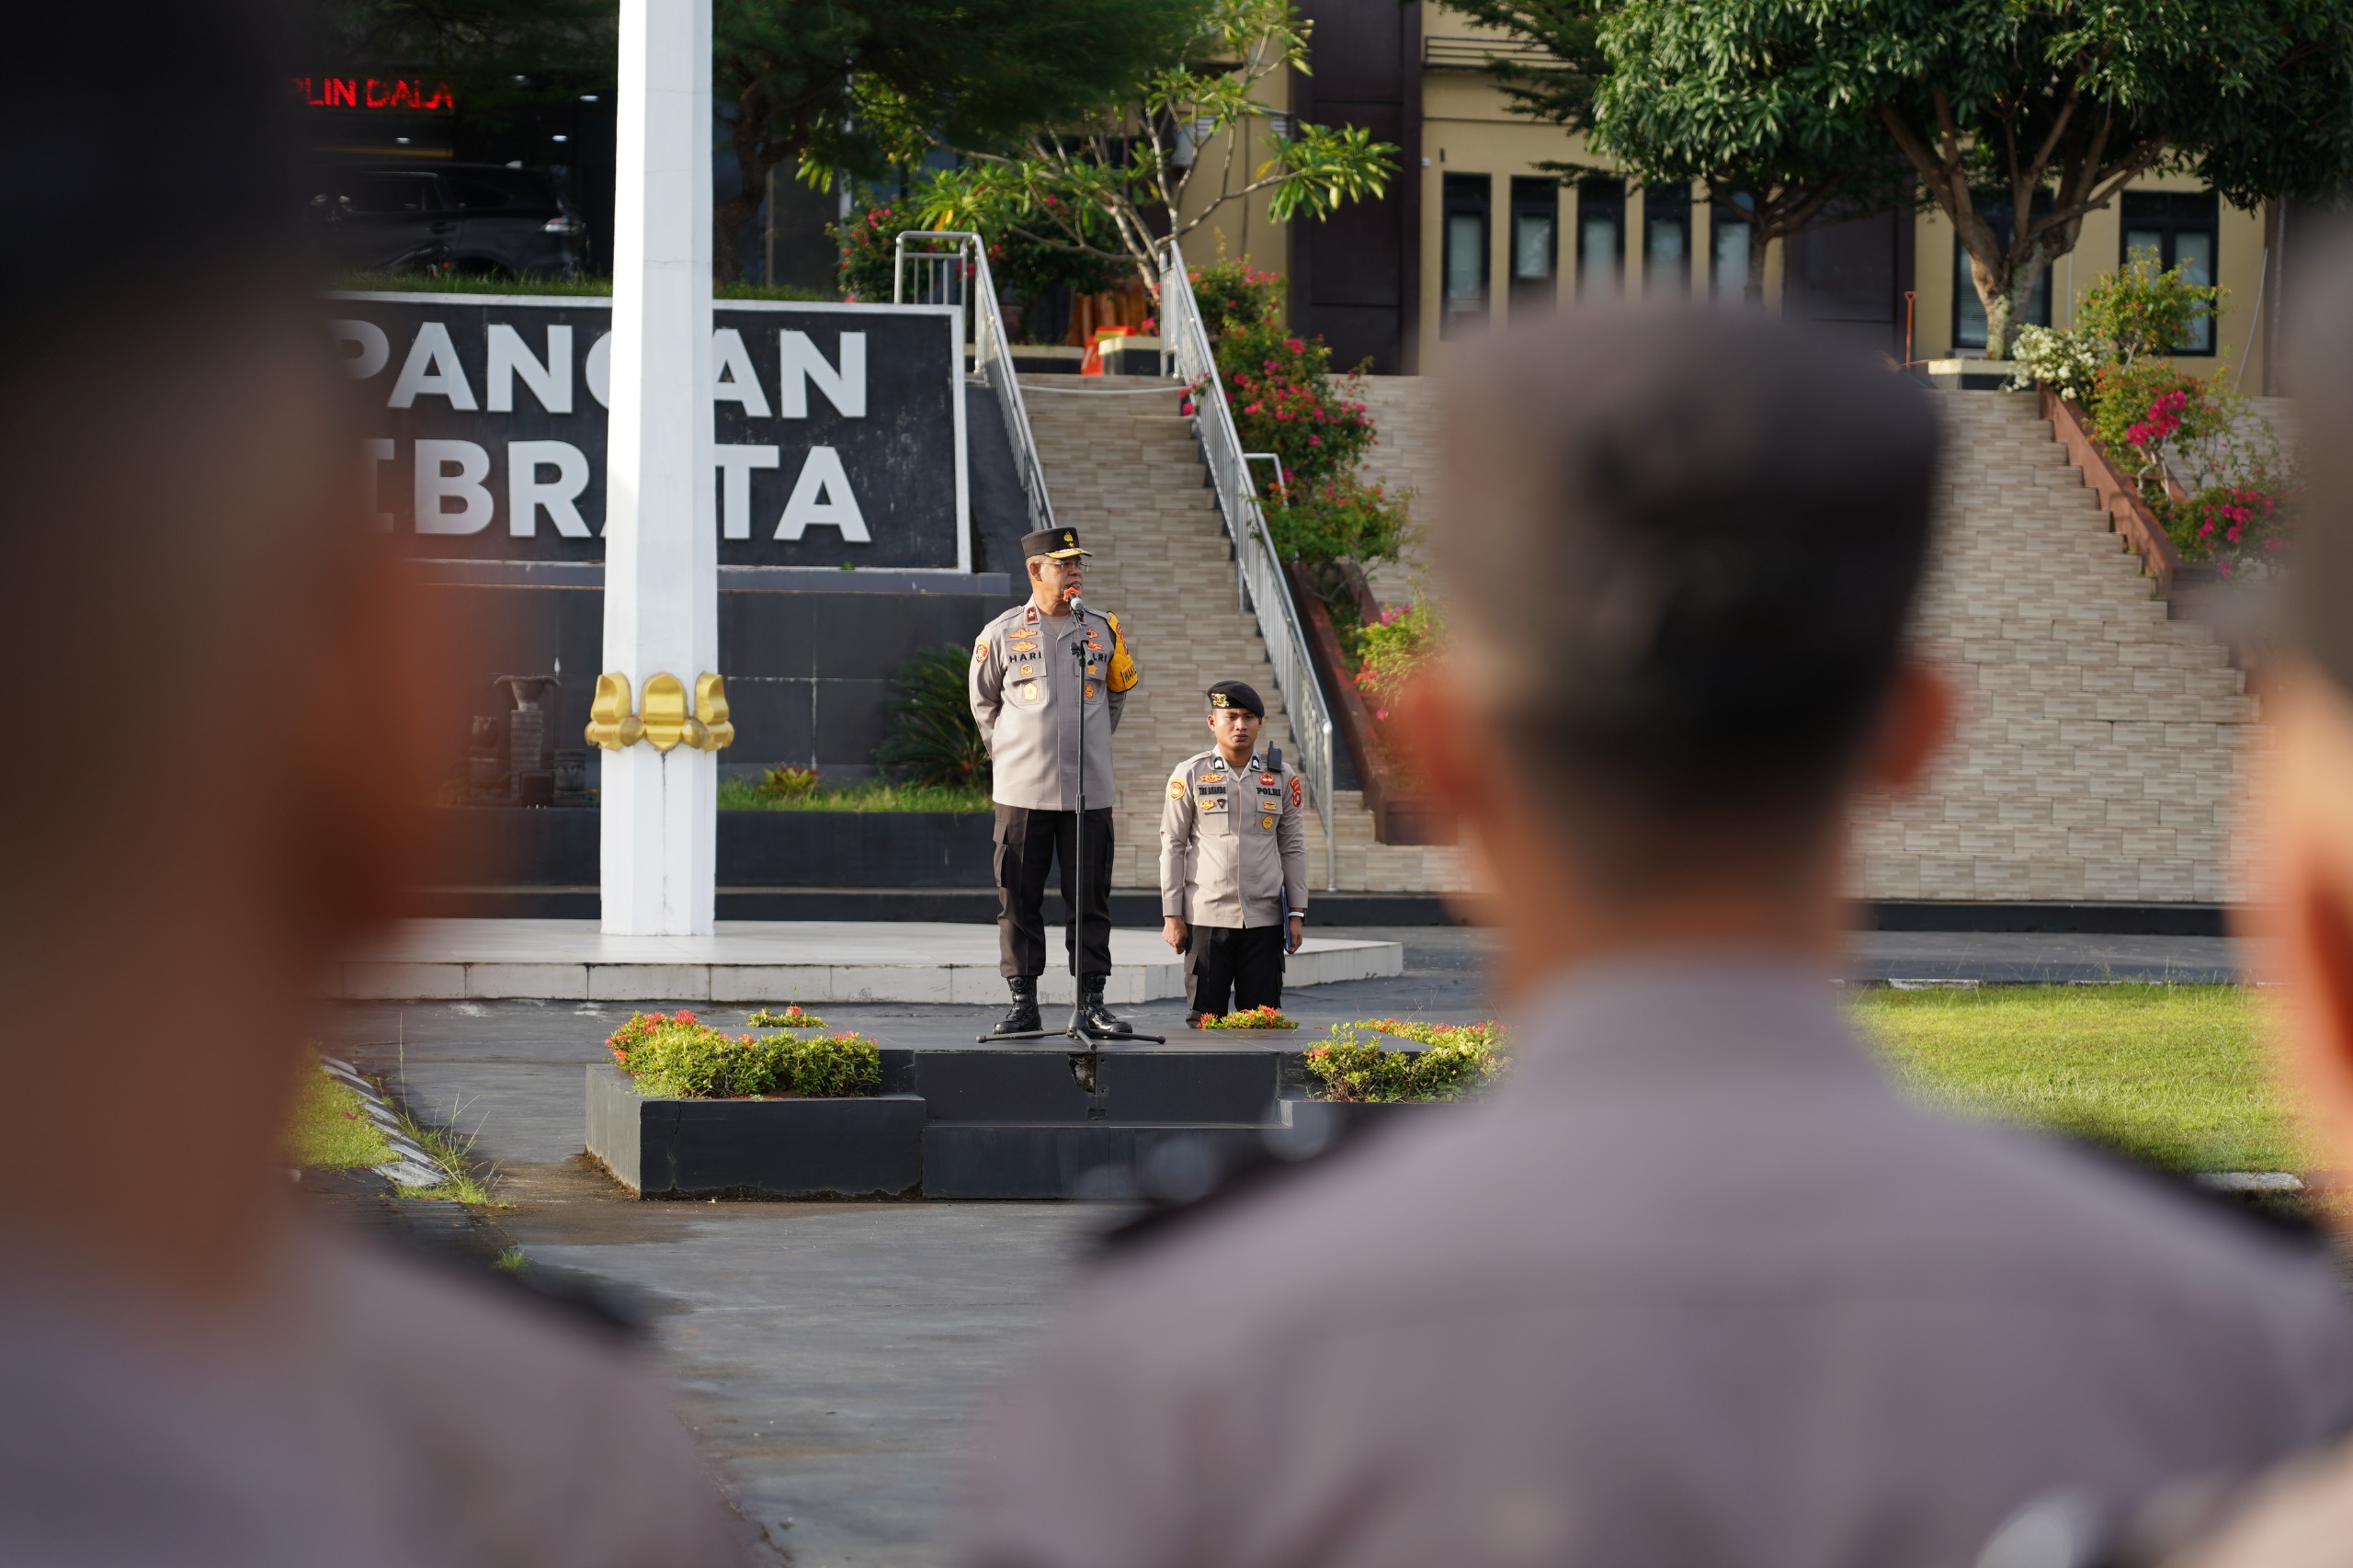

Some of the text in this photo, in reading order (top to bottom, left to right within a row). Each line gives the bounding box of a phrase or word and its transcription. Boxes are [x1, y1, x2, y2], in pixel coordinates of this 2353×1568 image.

[331, 318, 867, 419] PANAN
[1008, 652, 1041, 663] HARI
[1256, 787, 1281, 797] POLRI
